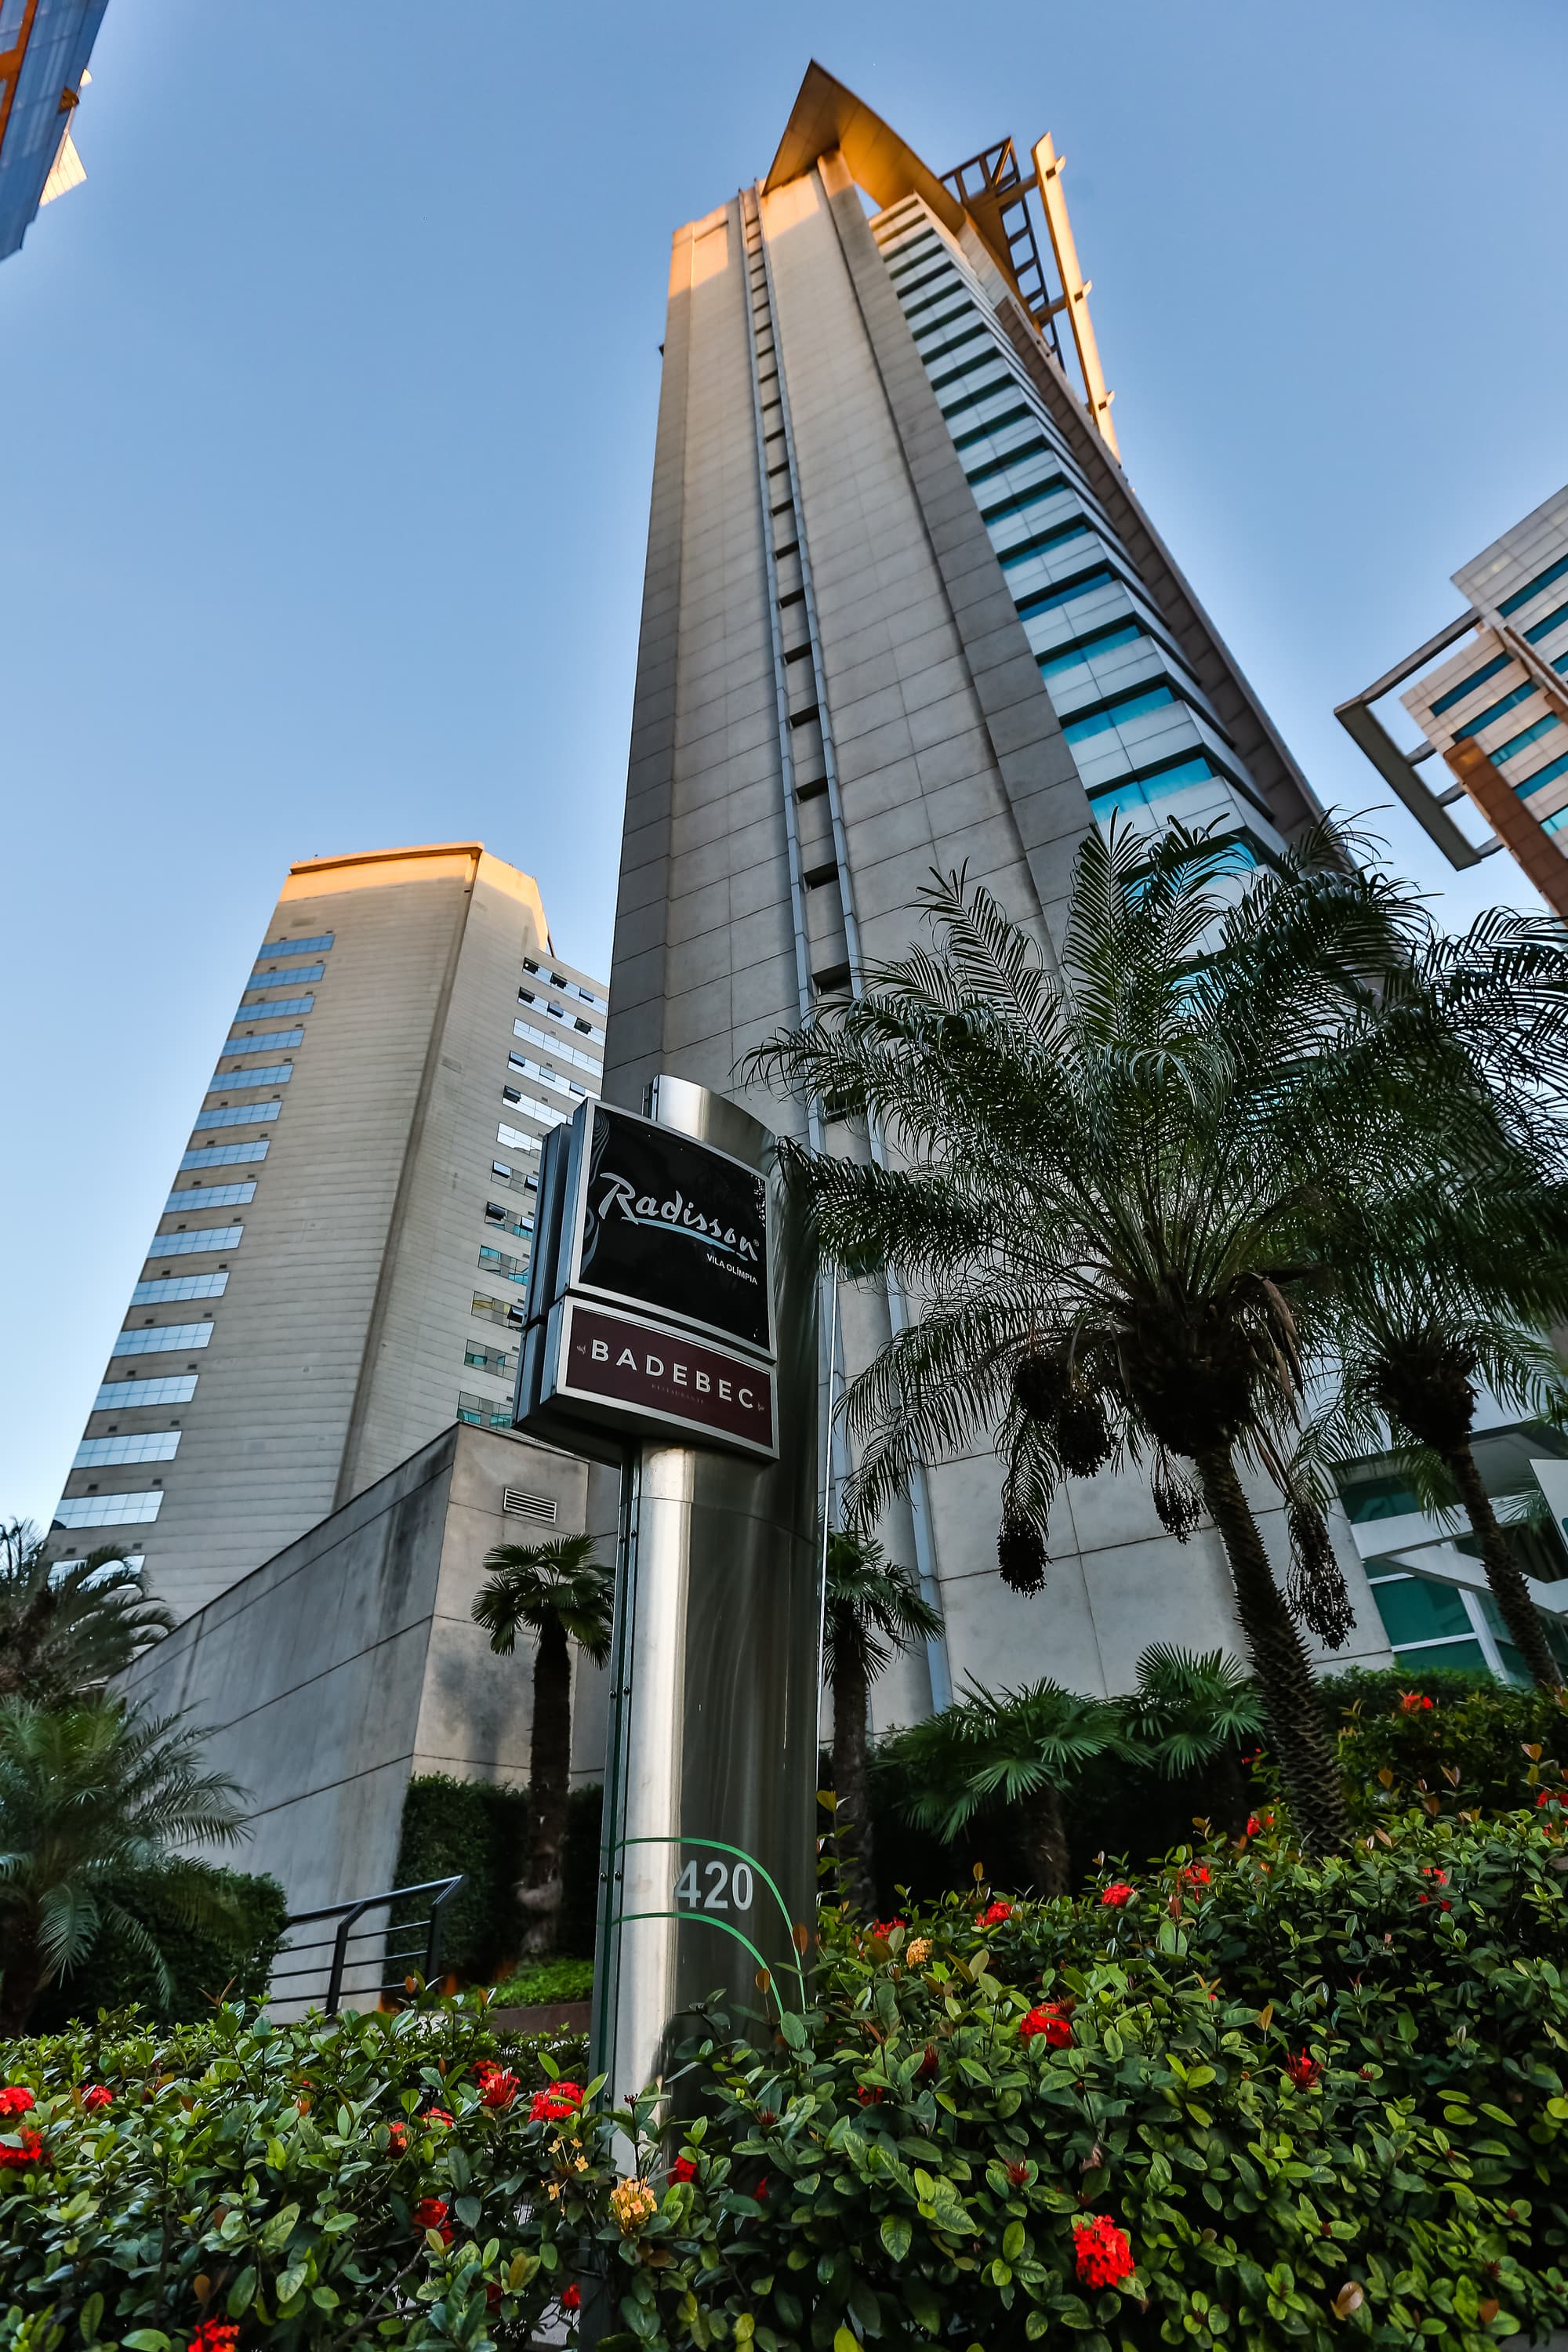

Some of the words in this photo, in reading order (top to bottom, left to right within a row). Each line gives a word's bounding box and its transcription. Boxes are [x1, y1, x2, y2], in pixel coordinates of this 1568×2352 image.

[598, 1172, 758, 1261] Radisson
[706, 1253, 725, 1269] VILA
[591, 1338, 753, 1409] BADEBEC
[674, 1860, 753, 1911] 420
